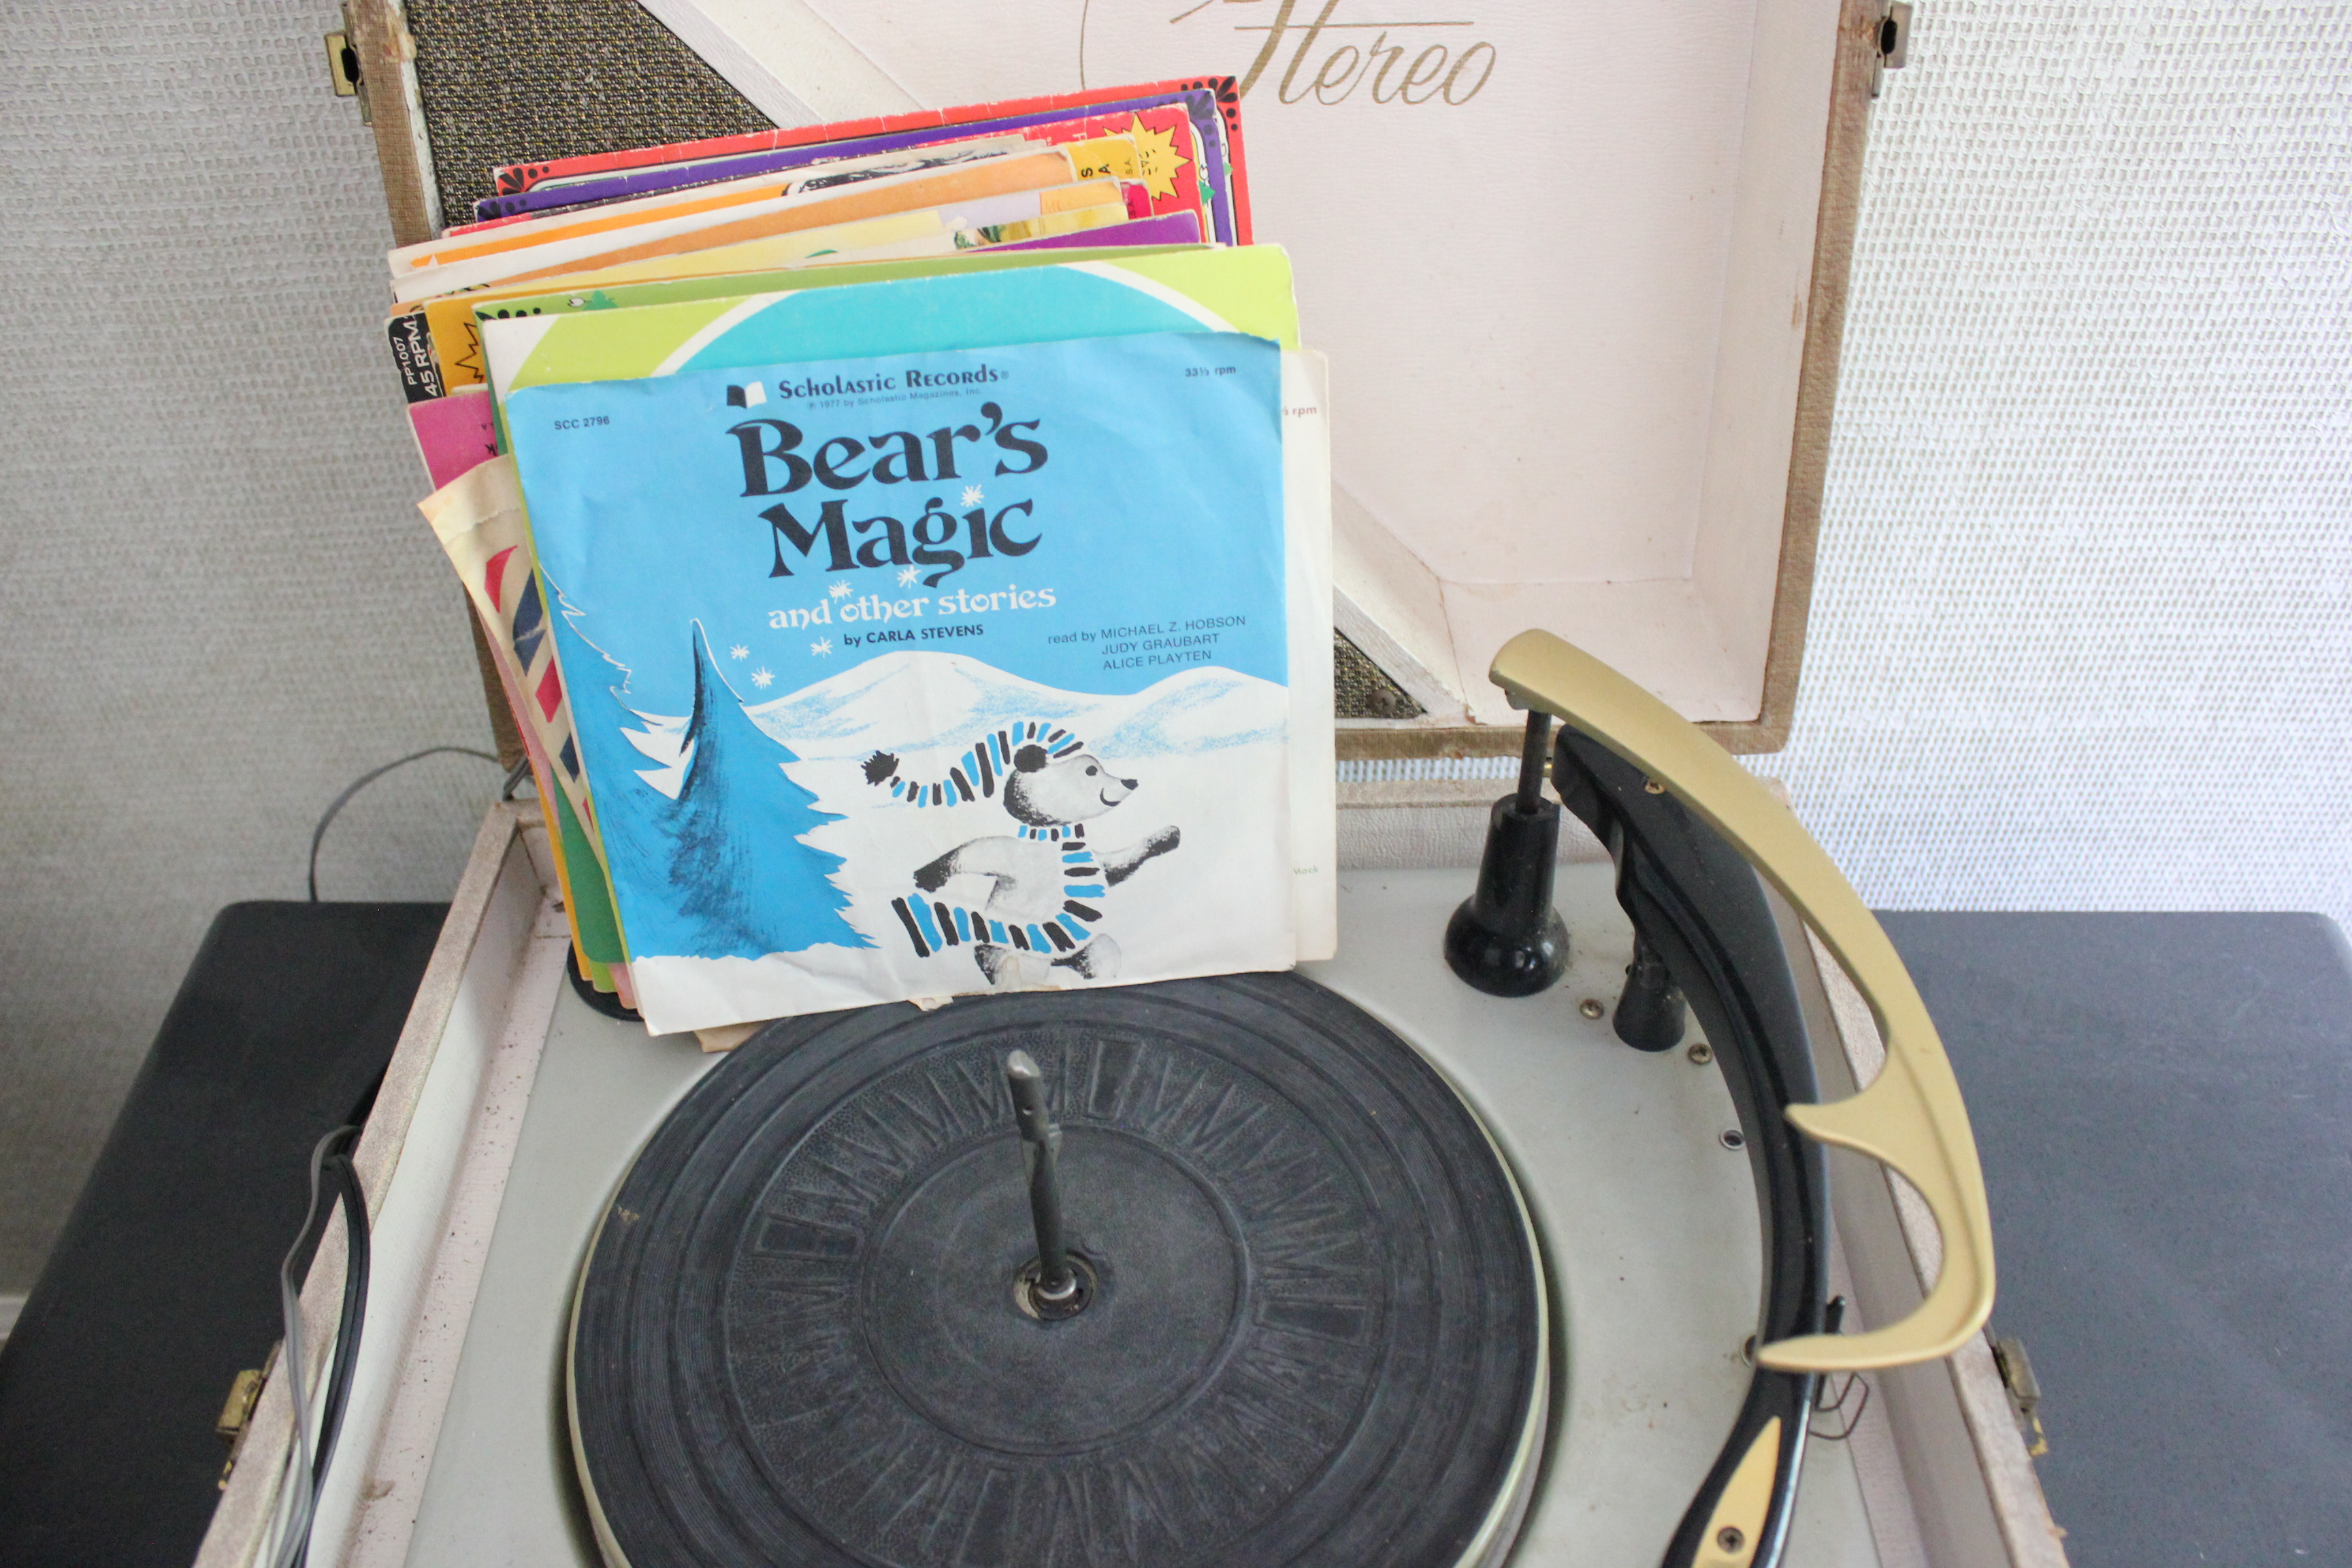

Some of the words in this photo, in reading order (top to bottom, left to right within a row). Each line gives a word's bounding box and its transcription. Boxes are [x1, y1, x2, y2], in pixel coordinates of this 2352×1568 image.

[403, 320, 431, 368] RPM
[393, 336, 418, 386] PP1007
[1215, 365, 1236, 376] rpm
[420, 370, 438, 397] 45
[819, 398, 840, 409] 1977
[843, 397, 855, 408] by
[858, 393, 906, 406] Scholastic
[1292, 406, 1317, 417] rpm
[554, 419, 580, 430] SCC
[584, 416, 610, 427] 2796
[725, 402, 1049, 497] Bear's
[757, 496, 1043, 589] Magic
[768, 600, 833, 630] and
[839, 594, 930, 623] other
[938, 583, 1057, 615] stories
[844, 634, 862, 648] by
[866, 629, 916, 644] CARLA
[921, 624, 984, 640] STEVENS
[1048, 632, 1077, 644] read
[1081, 631, 1096, 642] by
[1102, 623, 1164, 640] MICHAEL
[1169, 622, 1181, 632] Z.
[1186, 615, 1245, 630] HOBSON
[1102, 641, 1139, 655] JUDY
[1143, 633, 1220, 651] GRAUBART
[1103, 656, 1143, 670] ALICE
[1149, 650, 1211, 665] PLAYTEN
